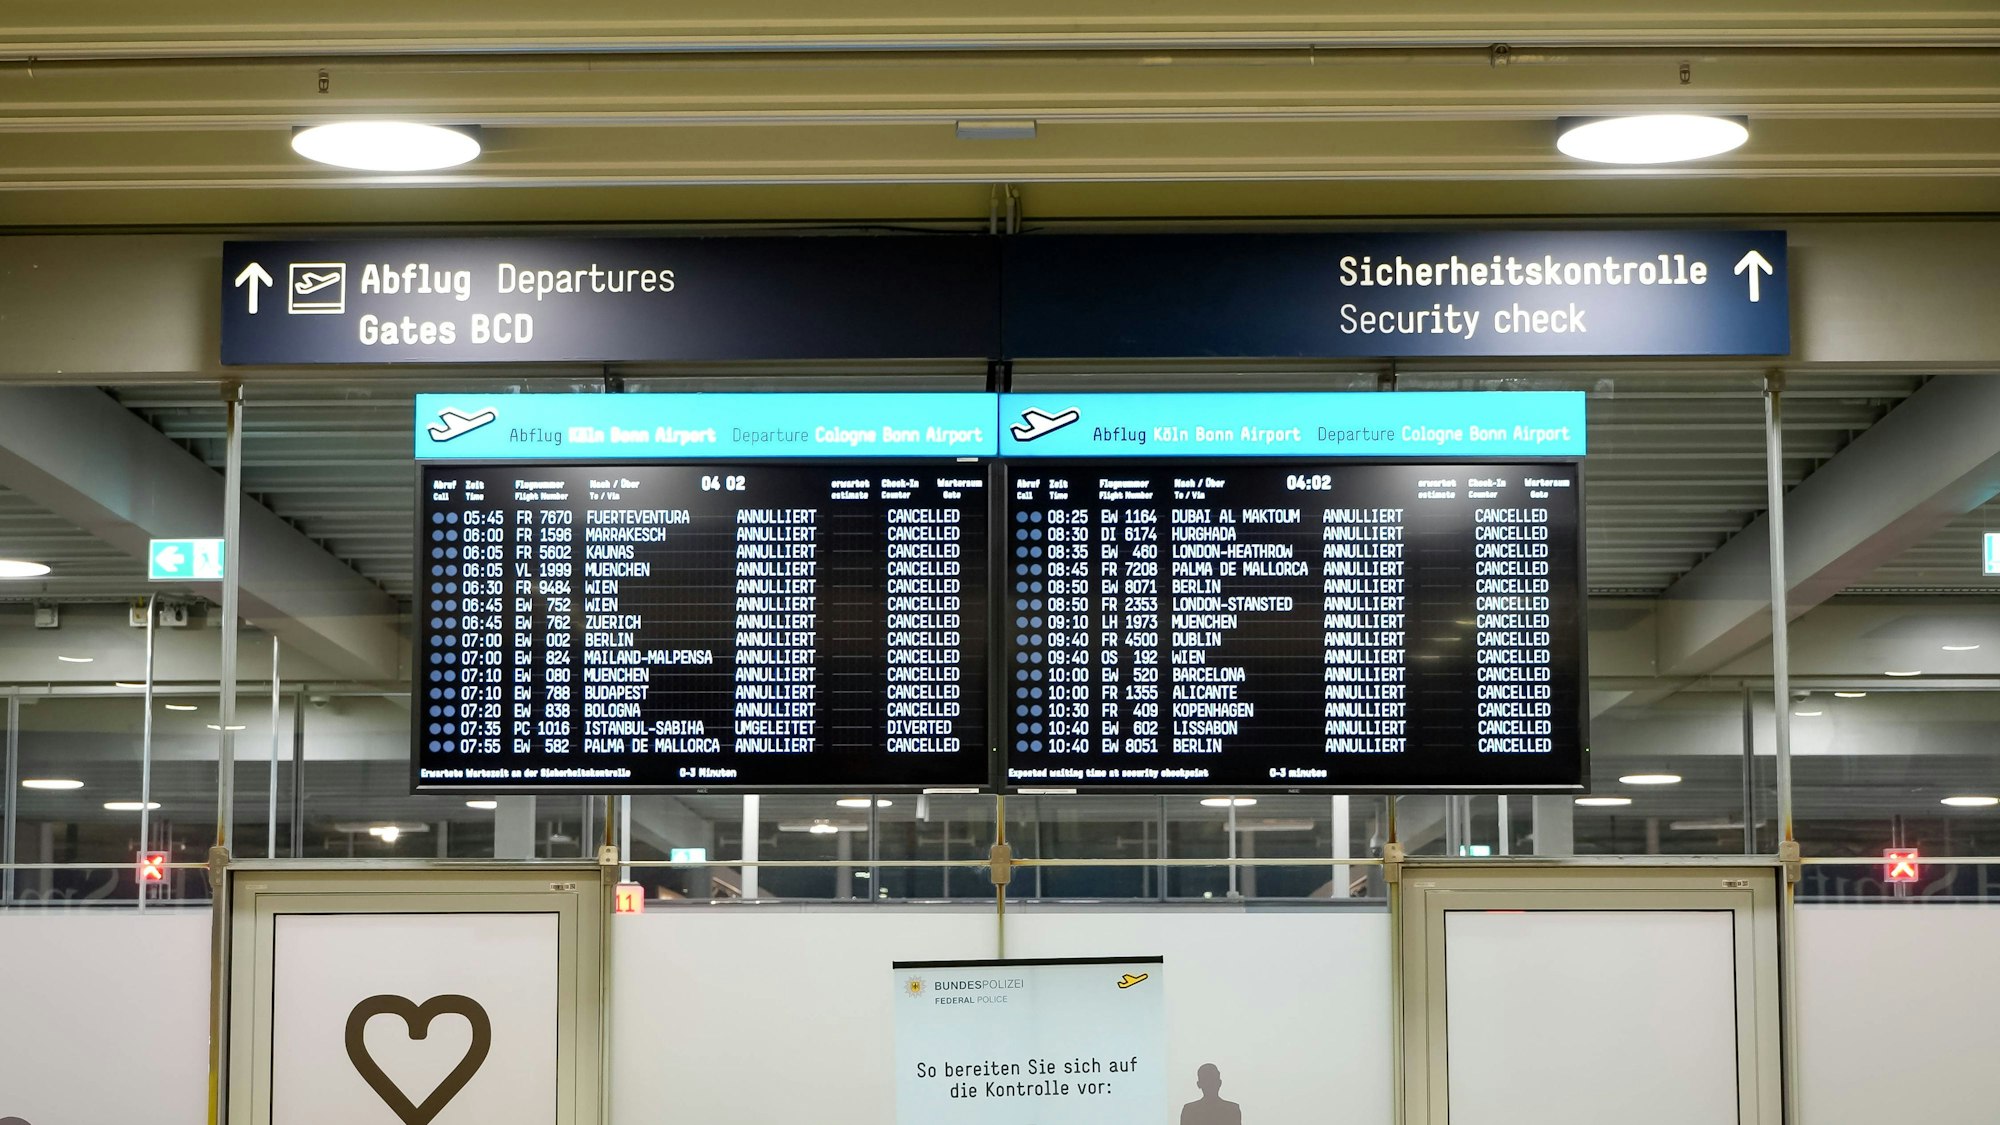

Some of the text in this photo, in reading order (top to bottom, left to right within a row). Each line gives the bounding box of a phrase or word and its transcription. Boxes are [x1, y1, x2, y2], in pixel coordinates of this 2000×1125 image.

[1339, 254, 1708, 286] Sicherheitskontrolle
[361, 263, 675, 301] Abflug Departures
[359, 313, 534, 345] Gates BCD
[1340, 302, 1587, 339] Security check
[509, 428, 562, 446] Abflug
[610, 427, 649, 443] Bonn
[655, 426, 717, 446] Airport
[733, 427, 984, 446] Departure Cologne Bonn Airport
[1093, 426, 1301, 445] Abflug Köln Bonn Airport
[1318, 425, 1571, 444] Departure Cologne Bonn Airport
[701, 475, 746, 491] 04 02
[1286, 474, 1332, 490] 04:02
[463, 508, 960, 525] 05:45 FR 7670 FUERTEVENTURA ANNULLIERT CANCELLED
[1047, 508, 1548, 524] 08:25 EW 1164 DUBAI AL MAKTOUM ANNULLIERT CANCELLED
[462, 543, 960, 560] 06:05 FR 5602 KAUNAS ANNULLIERT CANCELLED
[1047, 560, 1549, 577] 08:45 FR 7208 PALMA DE MALLORCA ANNULLIERT CANCELLED
[462, 578, 960, 595] 06:30 FR 9484 WIEN ANNULLIERT CANCELLED
[1047, 596, 1550, 612] 08:50 FR 2353 LONDON-STANSTED ANNULLIERT CANCELLED
[462, 613, 960, 631] 06:45 EW 762 ZUERICH ANNULLIERT CANCELLED
[1047, 631, 1550, 647] 09:40 FR 4500 DUBLIN ANNULLIERT CANCELLED
[461, 649, 960, 666] 07:00 EW 824 MAILAND-MALPENSA ANNULLIERT CANCELLED
[1048, 666, 1551, 683] 10:00 EW 520 BARCELONA ANNULLIERT CANCELLED
[460, 701, 960, 719] 07:20 EW 838 BOLOGNA ANNULLIERT CANCELLED
[1048, 702, 1551, 718] 10:30 FR 409 KOPENHAGEN ANNULLIERT CANCELLED
[460, 719, 952, 736] 07:35 PC 1016 ISTANBUL-SABIHA UMGELEITET DIVERTED
[1048, 737, 1552, 754] 10:40 EW 8051 BERLIN ANNULLIERT CANCELLED
[934, 979, 1024, 991] BUNDESPOLIZEI
[934, 995, 1008, 1005] FEDERAL POLICE
[917, 1057, 1138, 1078] So bereiten Sie sich auf
[950, 1080, 1112, 1099] die Kontrolle vor:
